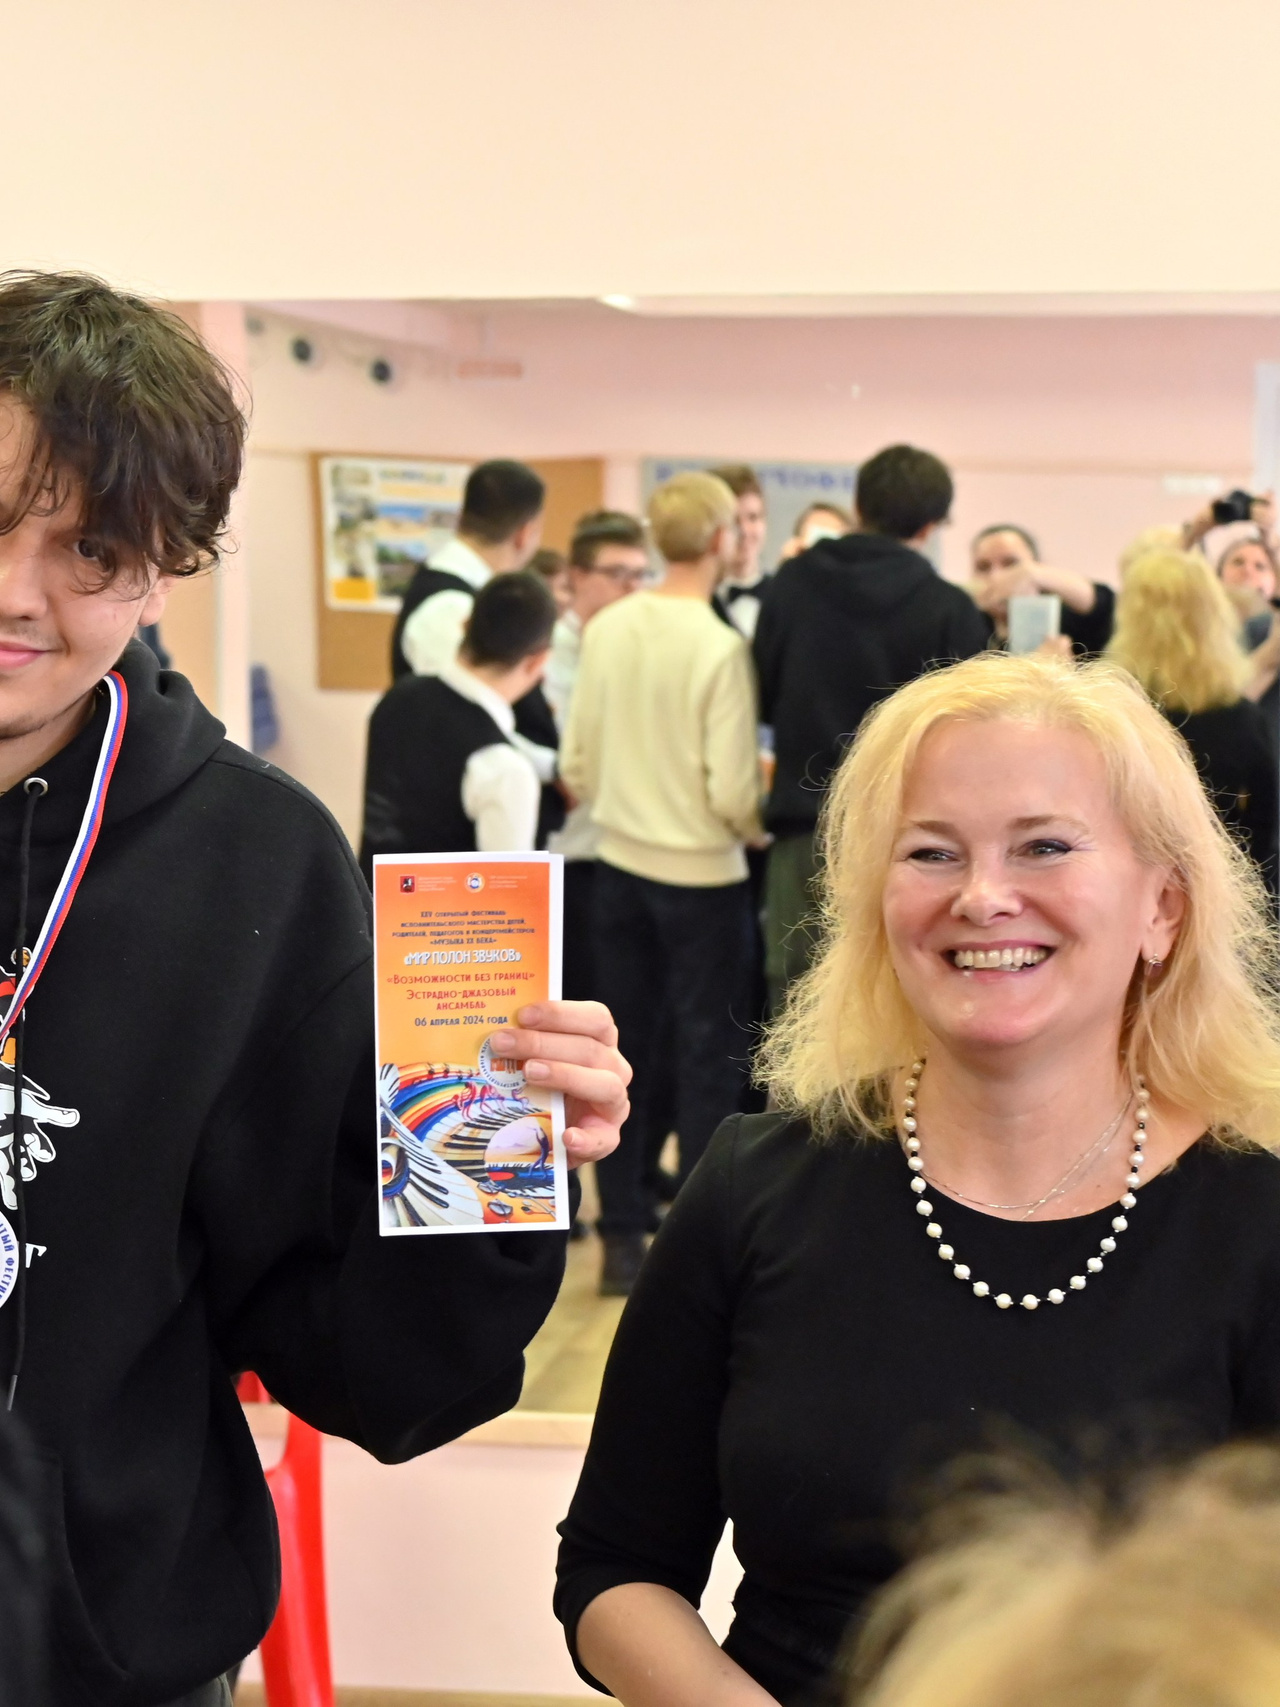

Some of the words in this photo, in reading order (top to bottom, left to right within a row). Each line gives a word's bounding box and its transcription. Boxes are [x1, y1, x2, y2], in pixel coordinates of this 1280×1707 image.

[432, 950, 471, 965] ПОЛОН
[473, 948, 523, 964] ЗВУКОВ»
[415, 1017, 427, 1027] 06
[462, 1015, 484, 1025] 2024
